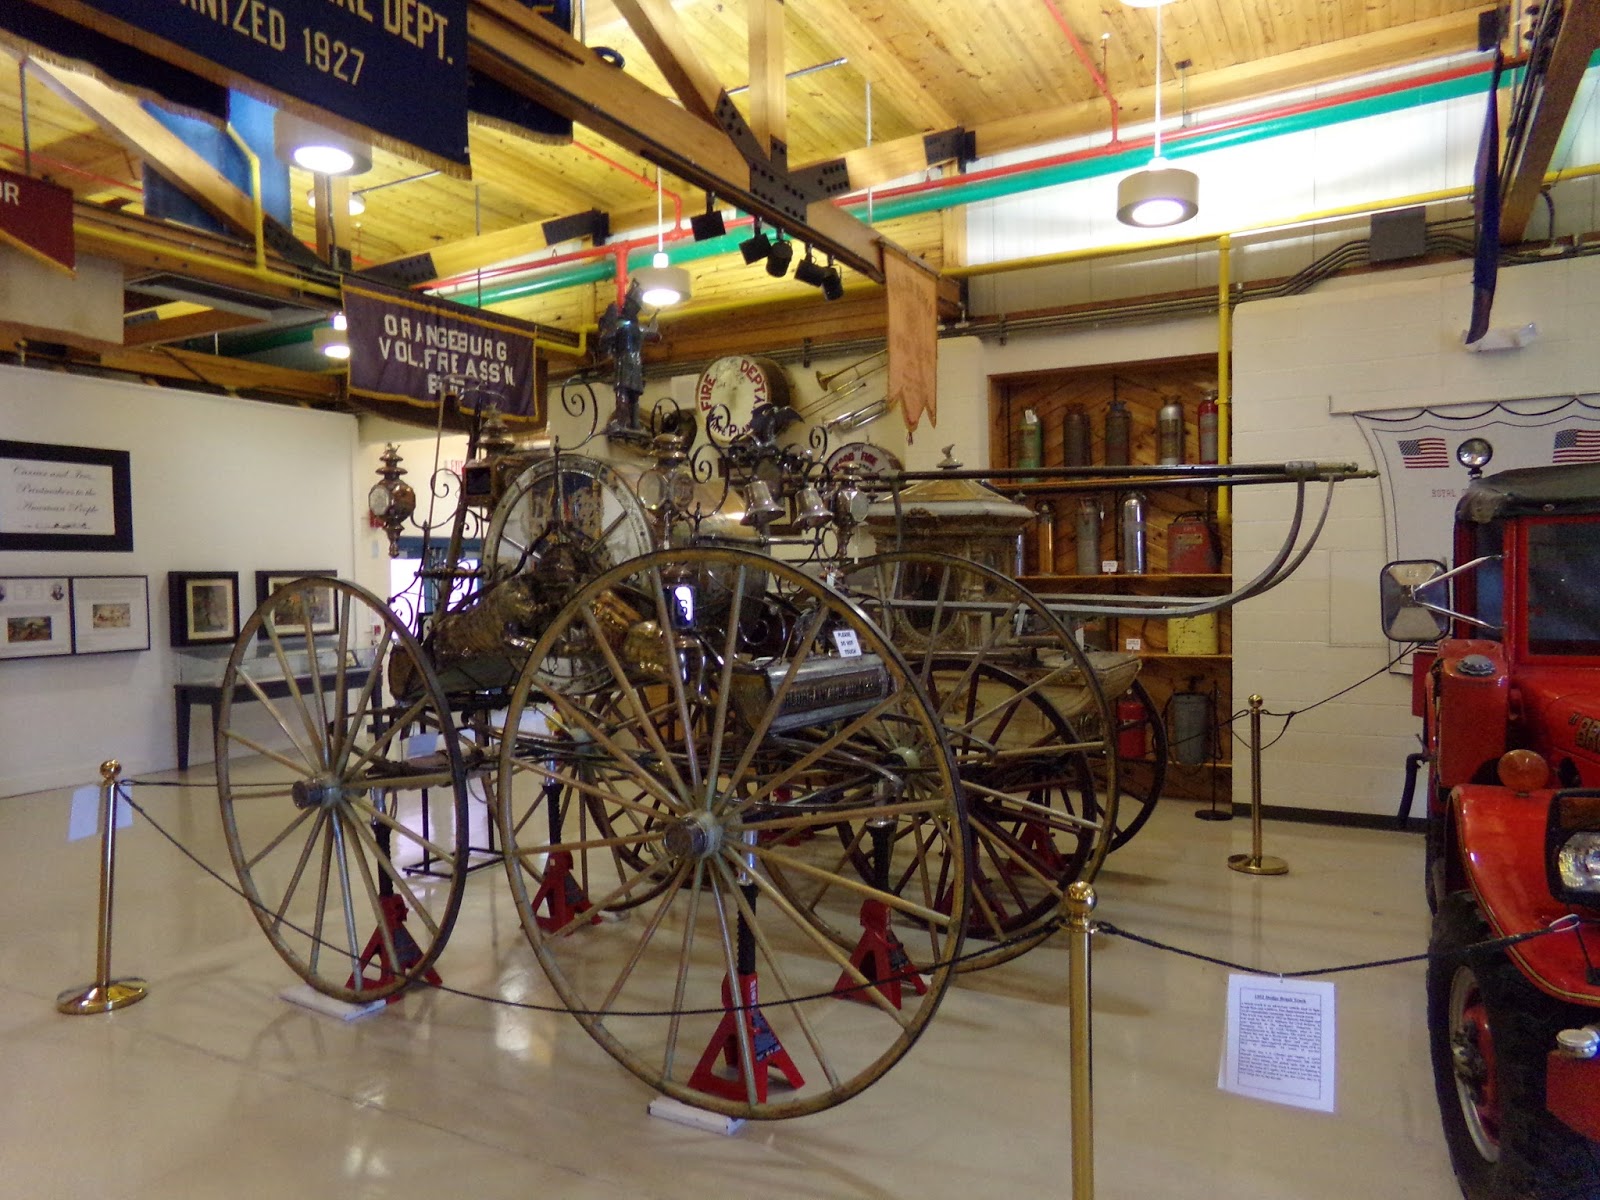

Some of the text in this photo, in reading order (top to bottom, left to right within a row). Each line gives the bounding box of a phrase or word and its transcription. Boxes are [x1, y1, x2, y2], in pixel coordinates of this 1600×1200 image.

[181, 0, 286, 51] NIZED
[303, 28, 365, 86] 1927
[384, 314, 507, 361] ORANGEBURG
[700, 373, 716, 412] FIRE
